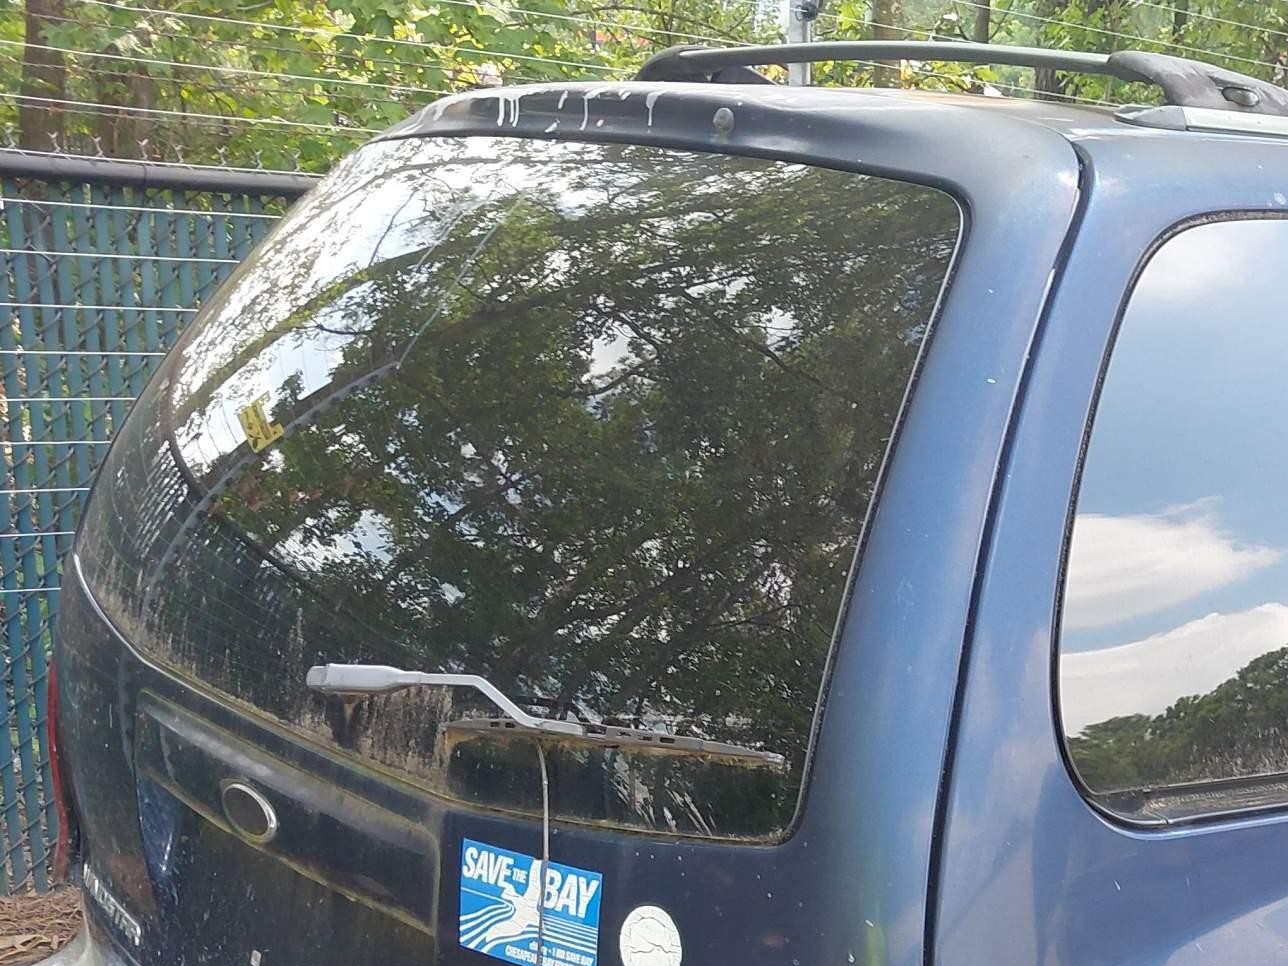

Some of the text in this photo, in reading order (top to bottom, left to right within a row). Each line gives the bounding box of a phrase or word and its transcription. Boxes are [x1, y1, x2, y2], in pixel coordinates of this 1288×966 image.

[463, 847, 599, 919] SAVE THE BAY
